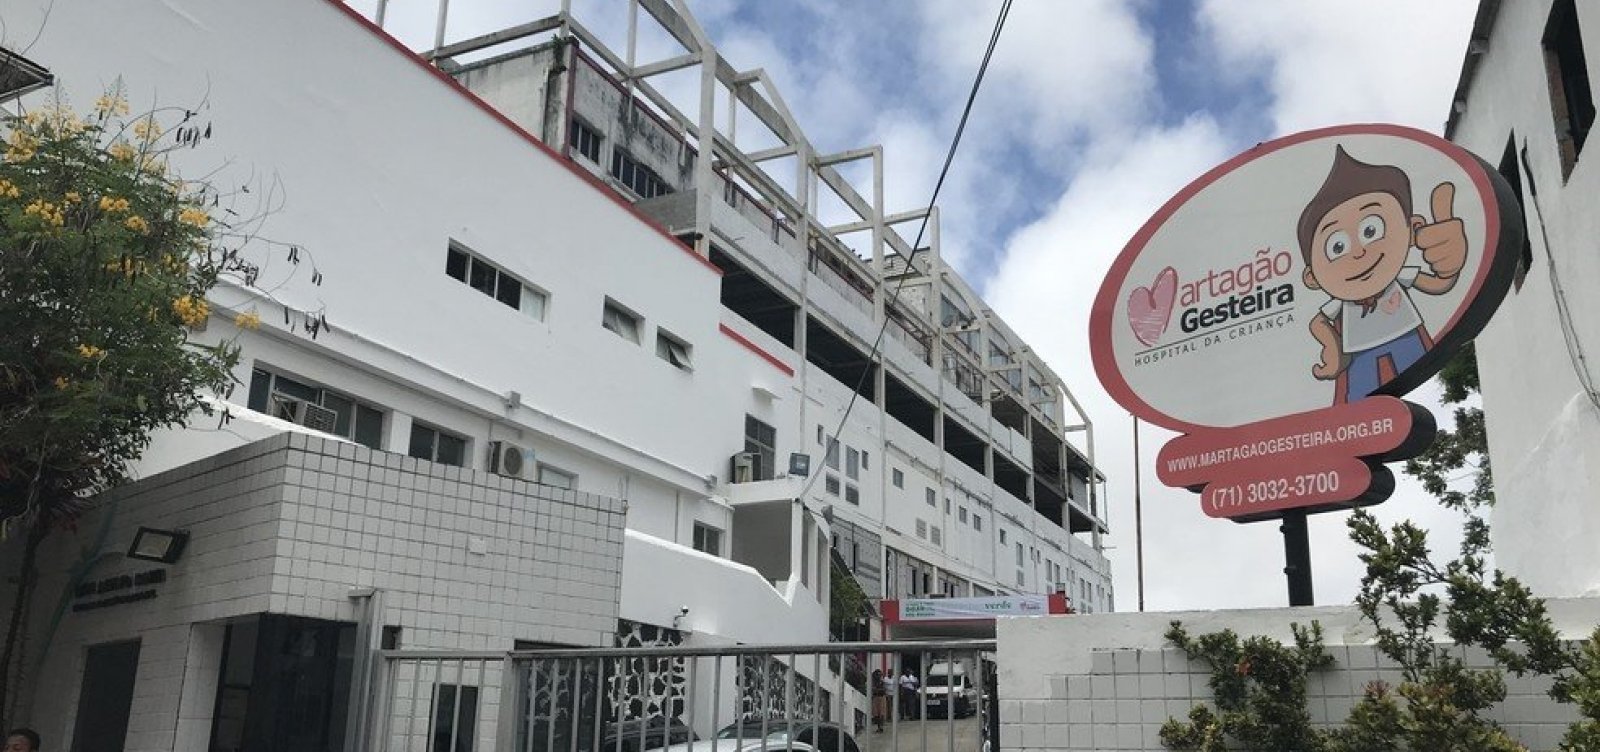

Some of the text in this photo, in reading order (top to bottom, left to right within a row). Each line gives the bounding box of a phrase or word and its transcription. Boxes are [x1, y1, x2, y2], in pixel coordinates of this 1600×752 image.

[1180, 283, 1295, 334] Gesteira
[1134, 314, 1295, 367] HOSPITAL DA CRIANÇA
[1167, 418, 1394, 473] WWW.MARTAGAOGESTEIRA.ORG.BR
[1212, 470, 1340, 510] (71) 3032-3700
